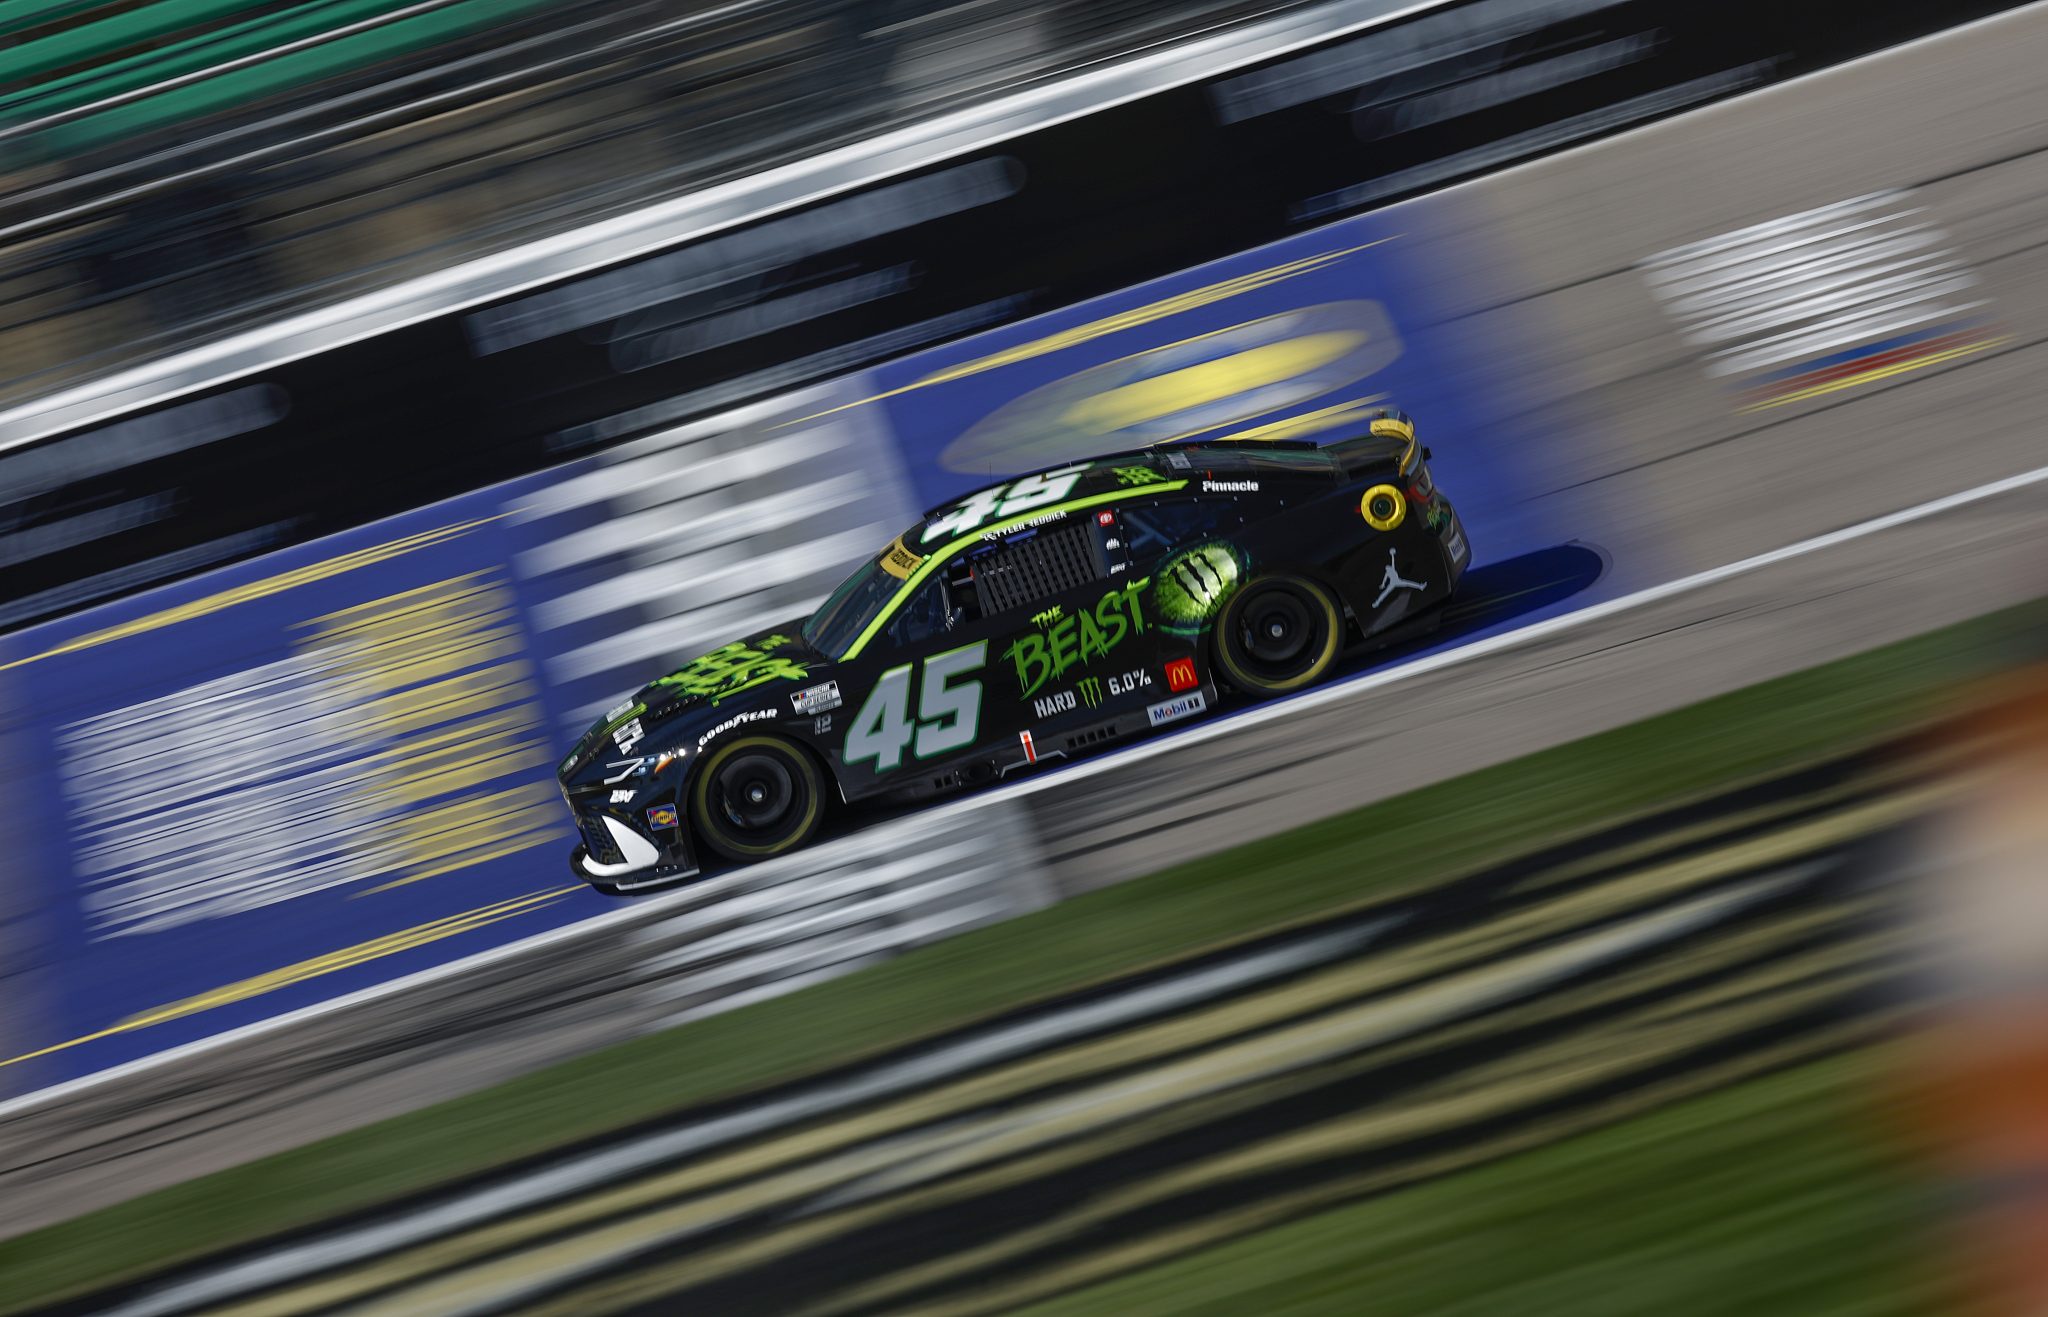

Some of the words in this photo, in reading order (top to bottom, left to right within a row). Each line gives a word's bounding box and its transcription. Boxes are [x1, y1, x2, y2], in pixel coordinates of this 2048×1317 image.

[1202, 480, 1260, 492] Pinnacle
[996, 522, 1027, 539] TYLER
[1029, 604, 1065, 630] THE
[1003, 577, 1150, 702] BEAST
[843, 638, 988, 774] 45
[1034, 690, 1077, 719] HARD
[1108, 668, 1152, 696] 6.0%
[1153, 701, 1187, 720] Mobil
[698, 708, 778, 747] GOODYEAR
